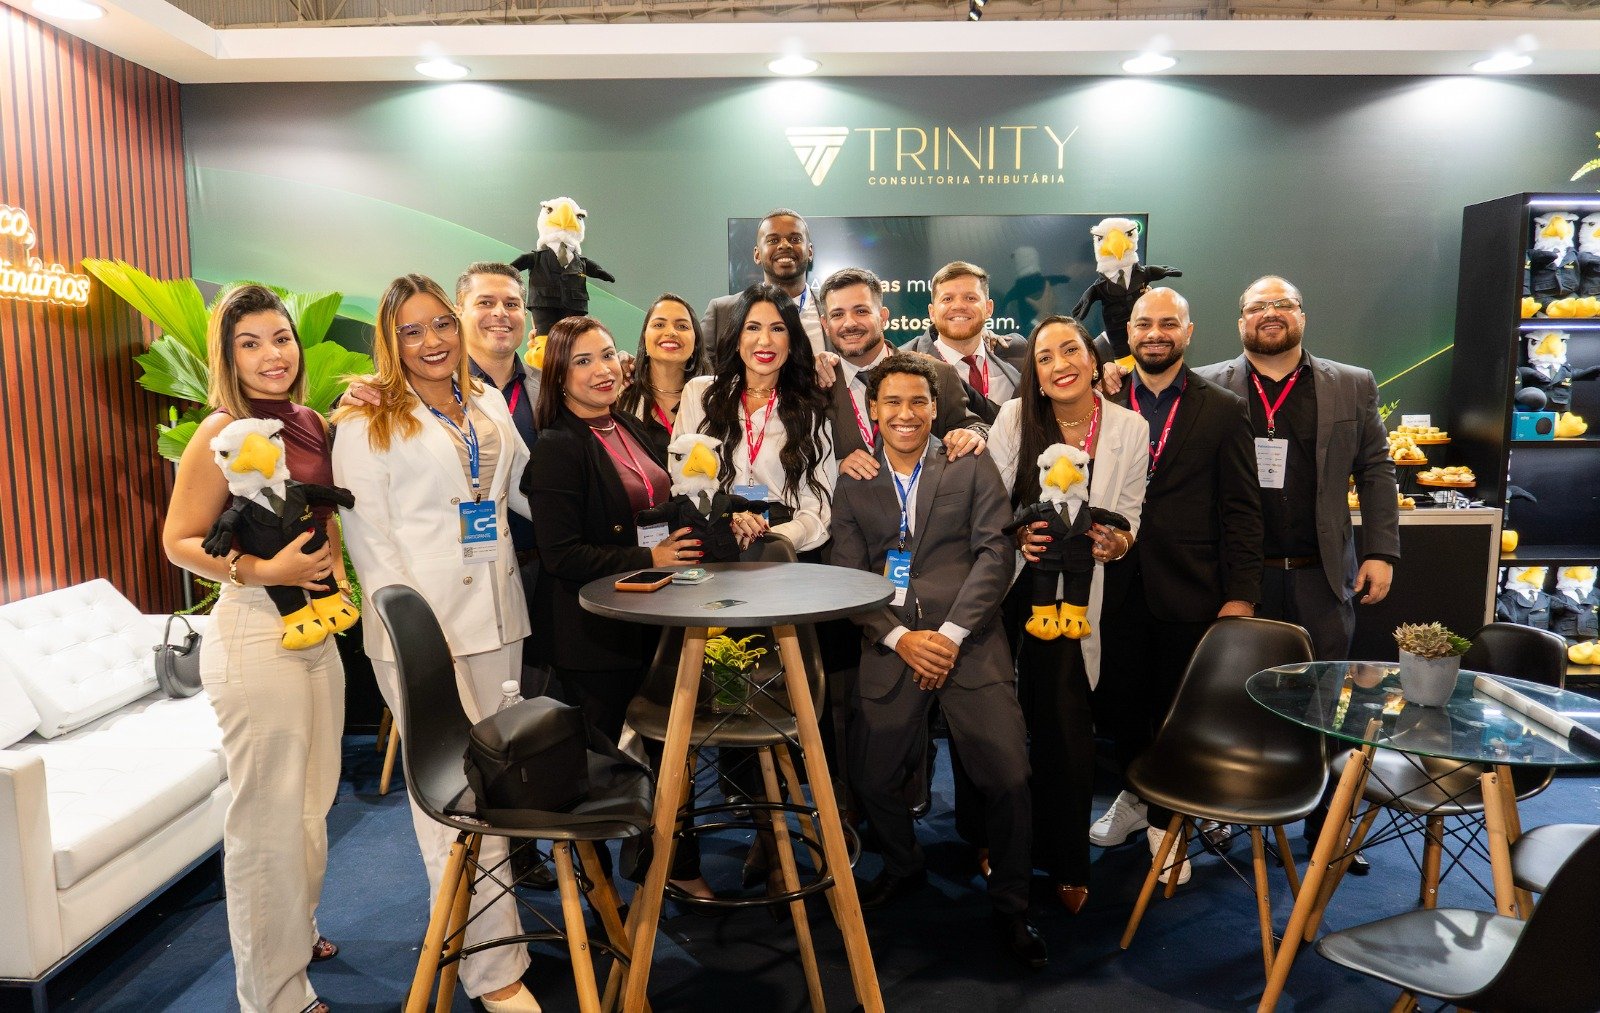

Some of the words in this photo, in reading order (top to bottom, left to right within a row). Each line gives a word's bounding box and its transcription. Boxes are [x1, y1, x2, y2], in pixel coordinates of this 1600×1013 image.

[854, 126, 1079, 171] TRINITY
[868, 175, 970, 185] CONSULTORIA
[978, 173, 1065, 184] TRIBUTÁRIA
[0, 257, 89, 301] inários
